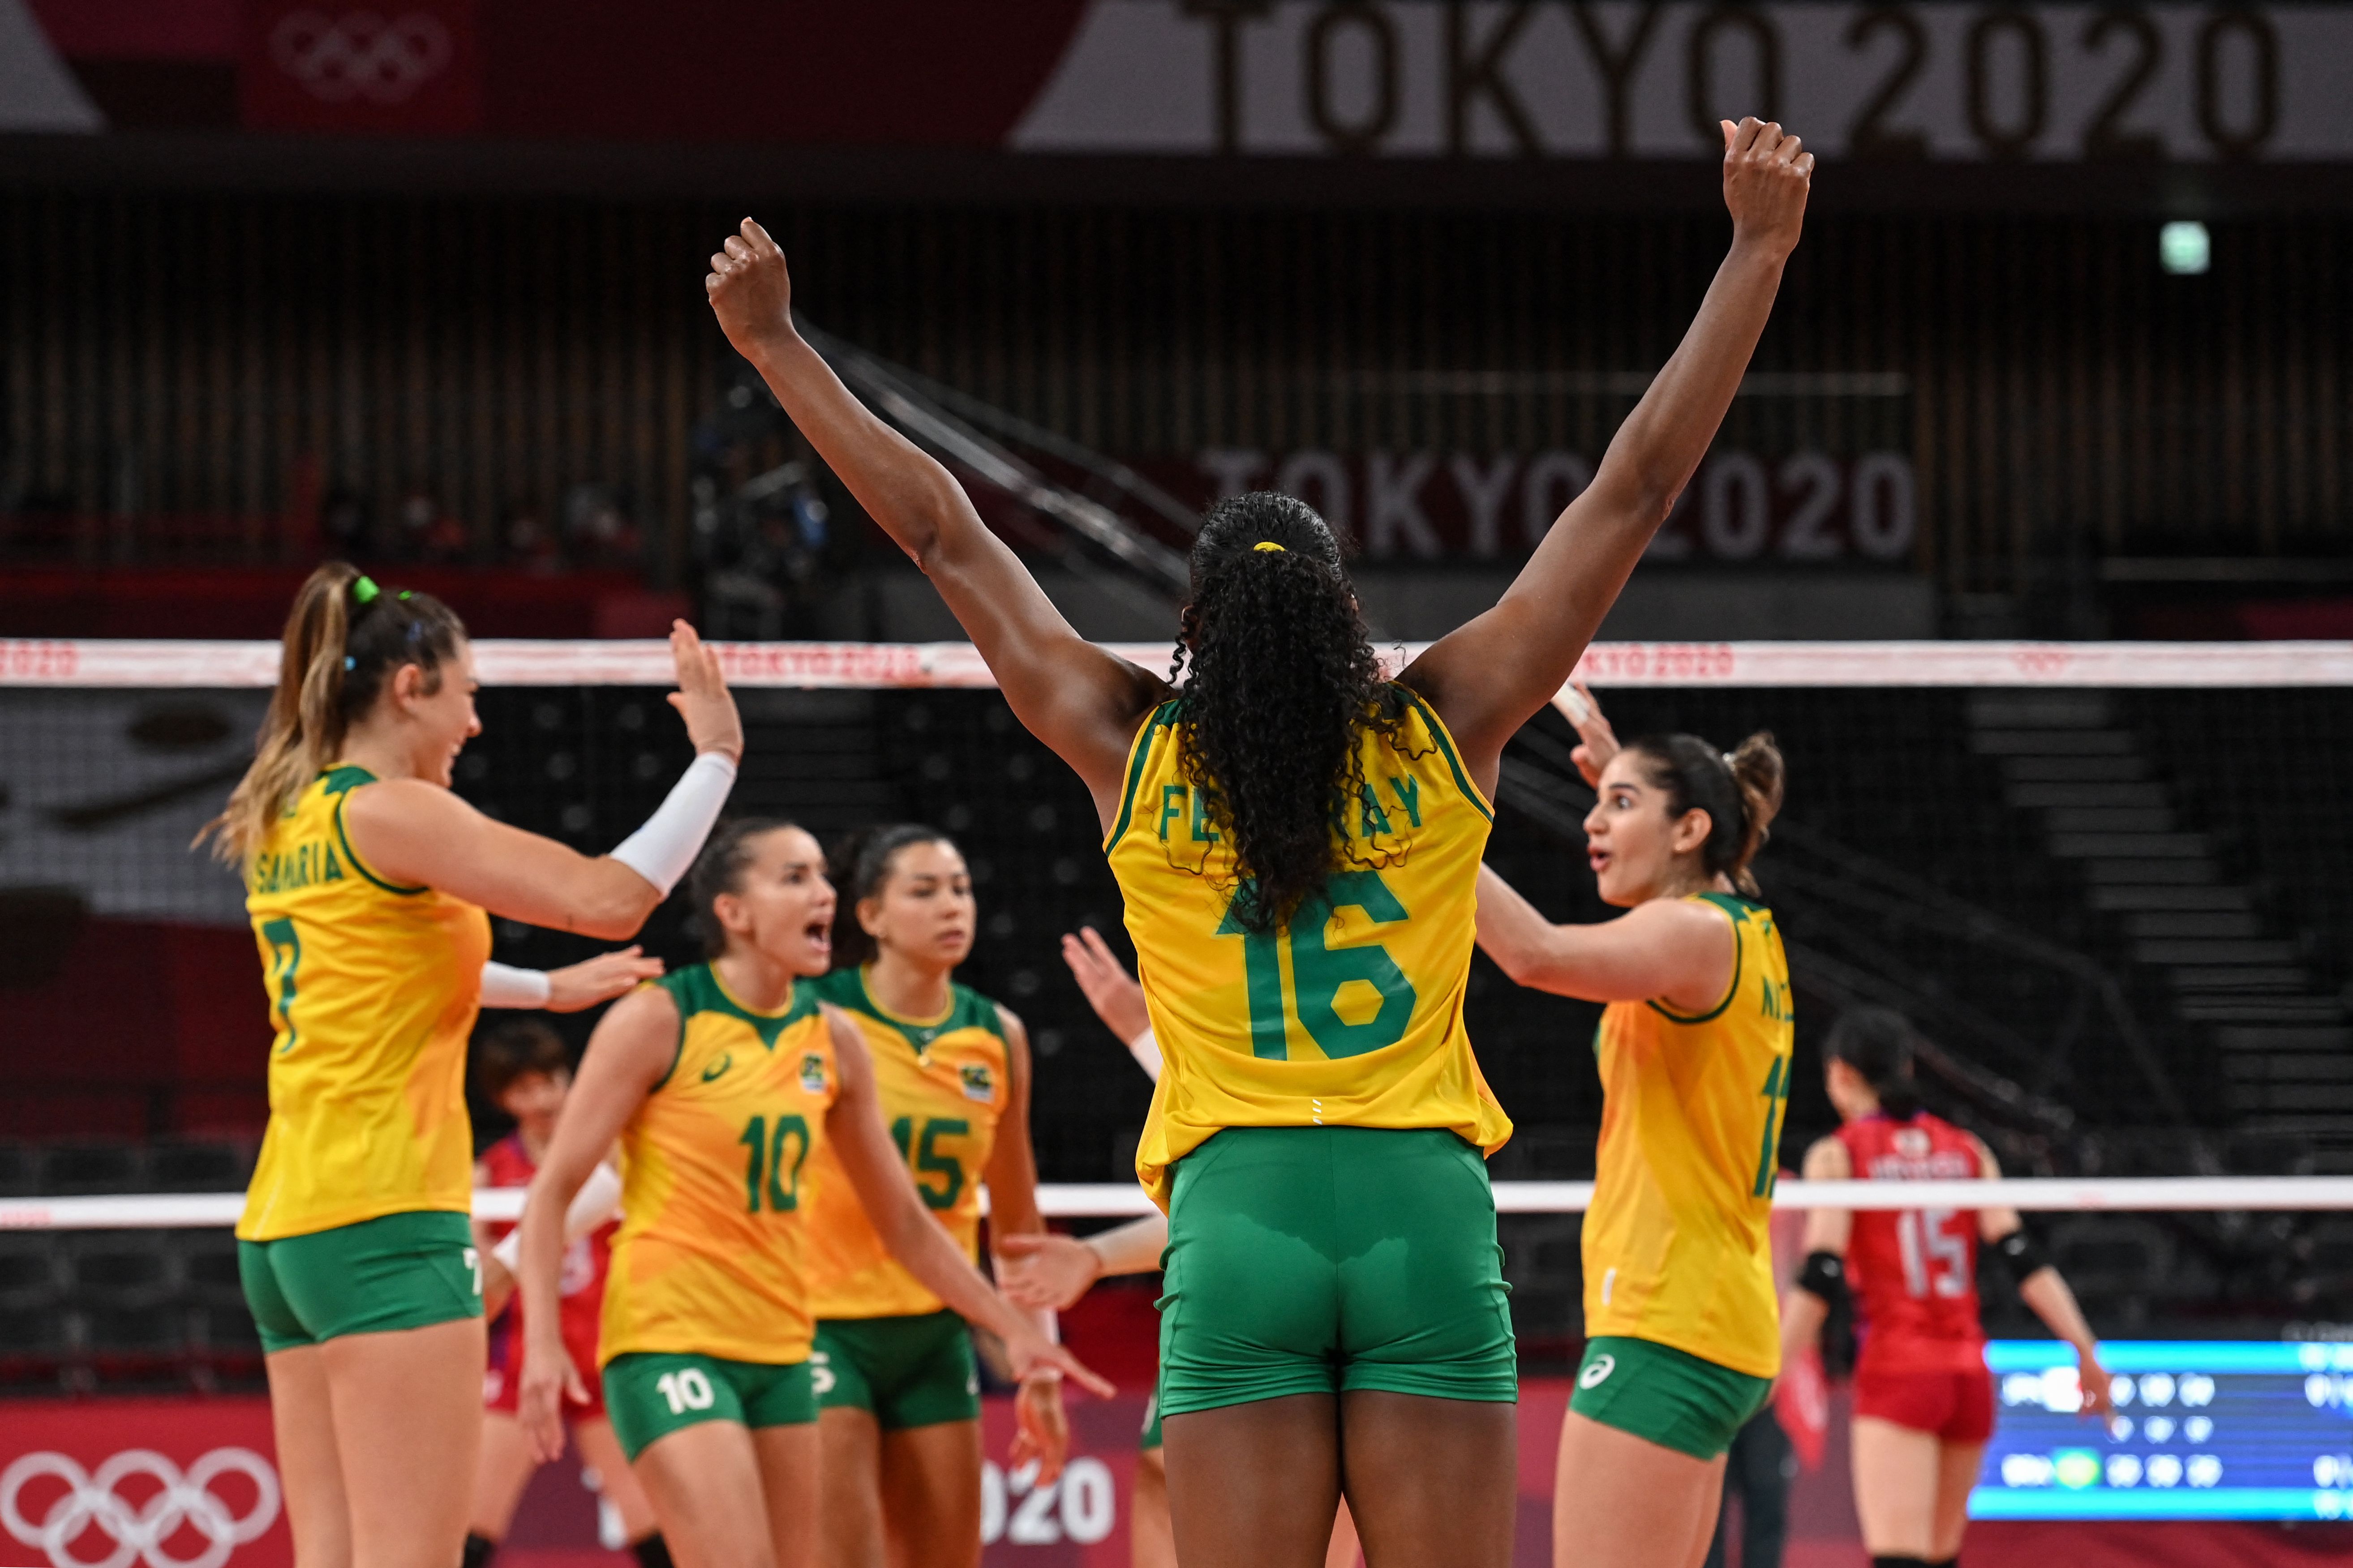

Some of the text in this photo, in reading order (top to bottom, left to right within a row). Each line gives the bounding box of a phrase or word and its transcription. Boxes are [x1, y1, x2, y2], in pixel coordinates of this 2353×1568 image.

[1182, 0, 2281, 159] TOKYO 2020
[1645, 450, 1915, 561] 020
[261, 915, 301, 1054] 7
[1215, 869, 1417, 1062] 16
[739, 1114, 810, 1212] 10
[656, 1367, 715, 1415] 10
[980, 1456, 1116, 1546] 020
